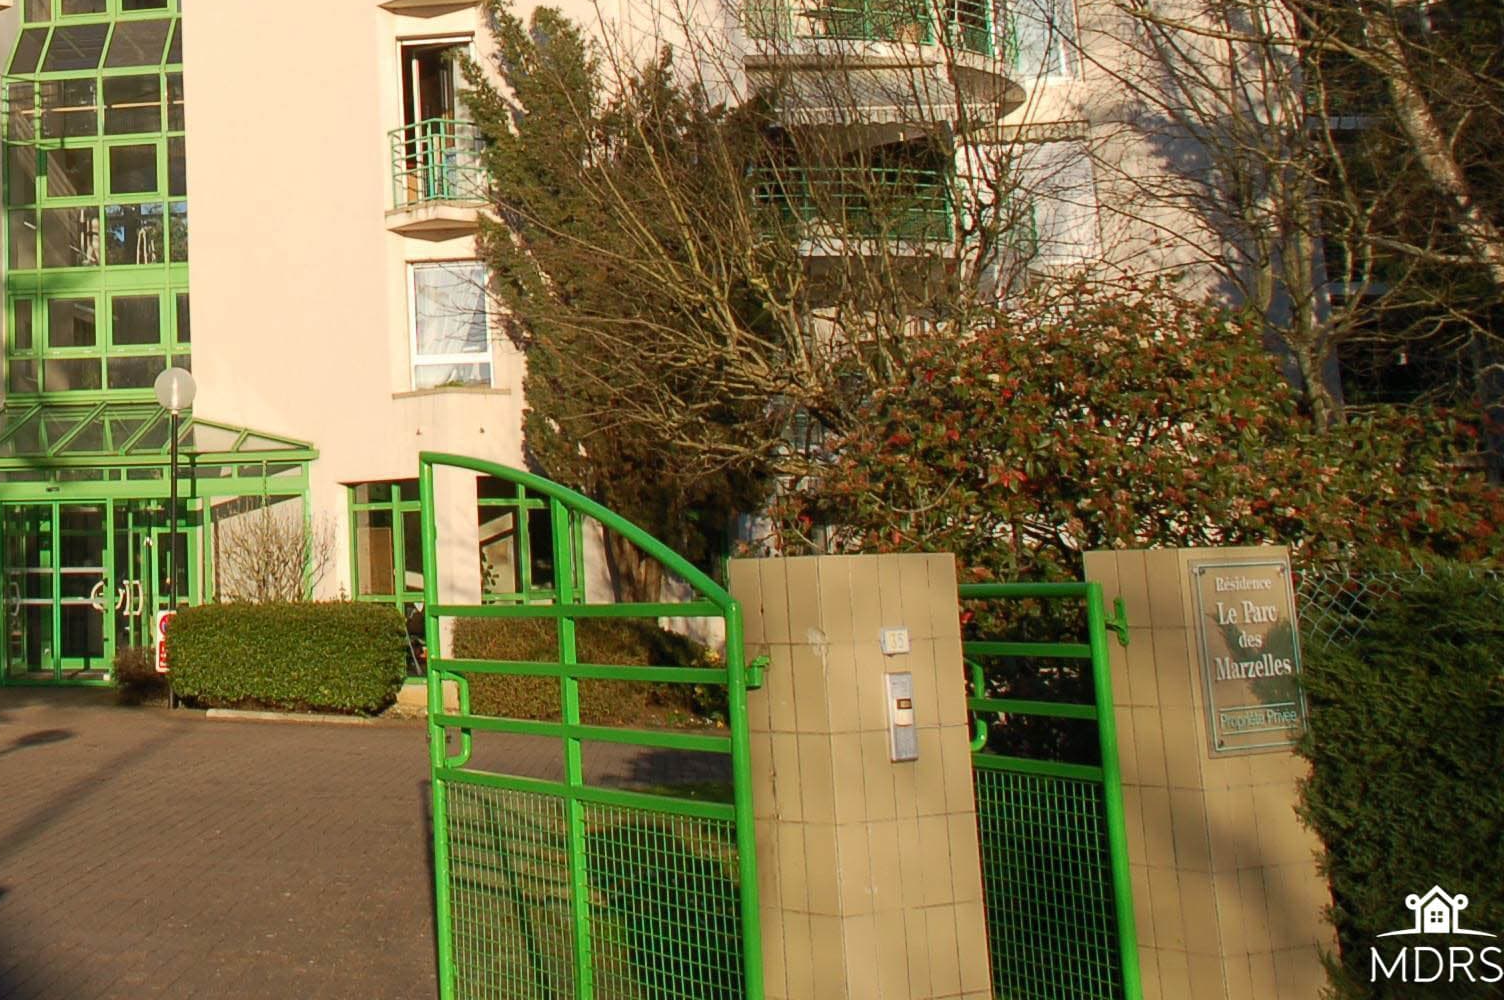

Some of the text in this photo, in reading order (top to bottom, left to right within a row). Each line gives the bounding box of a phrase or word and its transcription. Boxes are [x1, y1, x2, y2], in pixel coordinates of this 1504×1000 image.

[1215, 576, 1272, 593] Résidence
[1216, 600, 1278, 626] Le Parc
[1239, 631, 1263, 649] des
[1215, 653, 1293, 682] Marzelles
